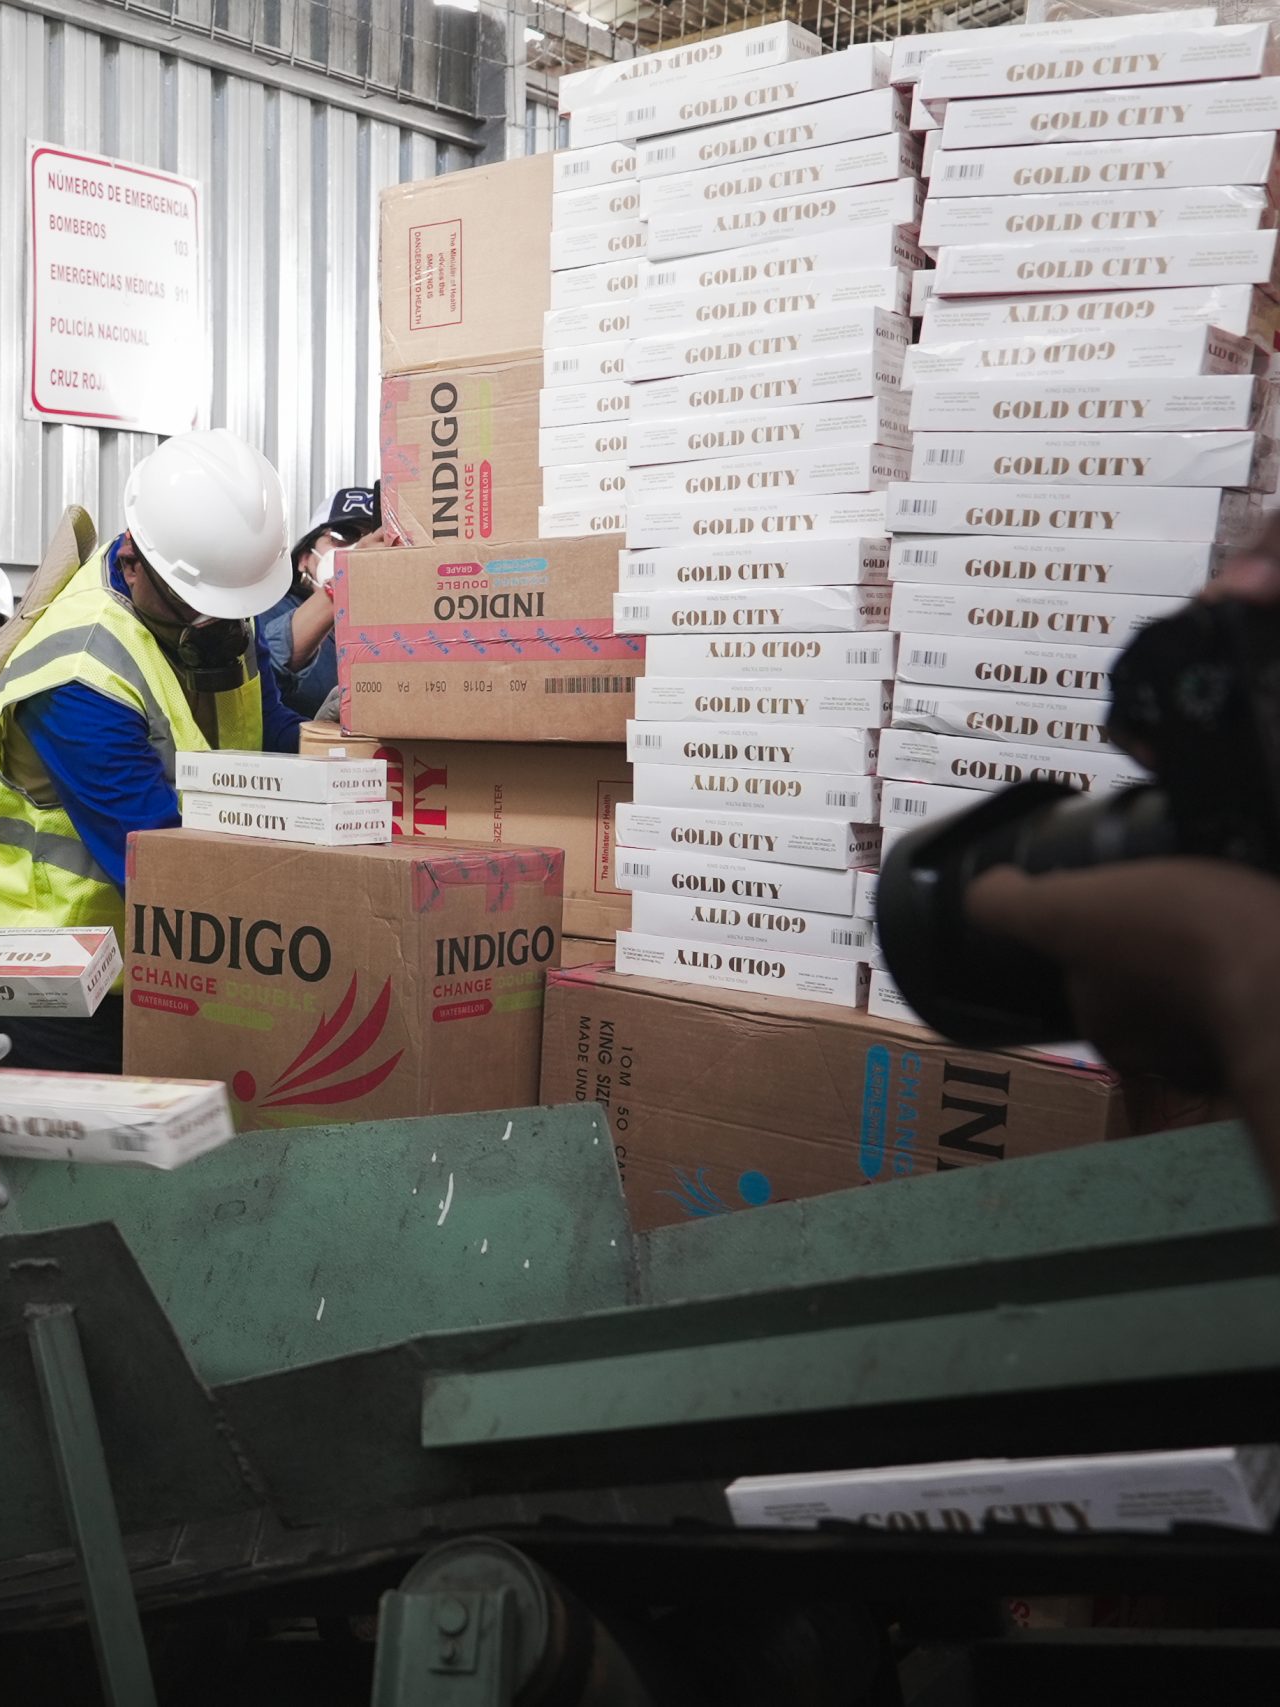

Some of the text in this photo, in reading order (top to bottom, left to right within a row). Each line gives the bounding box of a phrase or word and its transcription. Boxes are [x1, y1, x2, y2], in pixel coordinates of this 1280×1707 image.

[669, 44, 723, 69] GOLD
[1006, 53, 1166, 82] GOLD CITY
[679, 81, 799, 120] GOLD CITY
[1030, 108, 1109, 131] GOLD
[1117, 105, 1191, 127] CITY
[699, 123, 818, 161] GOLD CITY
[704, 165, 823, 200] GOLD CITY
[1013, 161, 1173, 186] GOLD CITY
[48, 170, 189, 218] NÚMEROS DE EMERGENCIA
[49, 214, 107, 239] BOMBEROS
[713, 200, 836, 233] GOLD CITY
[1006, 213, 1082, 232] GOLD
[1091, 210, 1164, 230] CITY
[608, 233, 647, 251] GOL
[50, 263, 122, 291] EMERGENCIAS
[699, 255, 818, 287] GOLD CITY
[1016, 260, 1093, 279] GOLD
[1101, 257, 1174, 276] CITY
[696, 293, 820, 322] GOLD CITY
[1002, 300, 1154, 324] GOLD CITY
[50, 316, 150, 346] POLICÍA NACIONAL
[685, 335, 802, 364] GOLD CITY
[976, 341, 1115, 368] GOLD CITY
[50, 368, 78, 388] CRUZ
[875, 371, 897, 385] GOLD
[689, 378, 802, 408] GOLD CITY
[993, 400, 1069, 420] GOLD
[1078, 400, 1151, 419] CITY
[688, 423, 805, 450] GOLD CITY
[879, 418, 898, 431] GOLD
[431, 382, 459, 539] INDIGO
[871, 464, 892, 477] GOLD
[994, 457, 1151, 476] GOLD CITY
[686, 469, 799, 494] GOLD CITY
[464, 463, 475, 540] CHANGE
[482, 471, 490, 529] WATERMELON
[590, 514, 625, 531] GOL
[693, 514, 818, 536] GOLD CITY
[965, 507, 1120, 530] GOLD CITY
[445, 565, 473, 575] GRAPE
[677, 562, 789, 583] GOLD CITY
[863, 558, 886, 568] GOLD
[965, 558, 1114, 583] GOLD CITY
[437, 579, 488, 590] DOUBLE
[434, 591, 545, 621] INDIGO
[672, 608, 784, 626] GOLD CITY
[858, 606, 881, 616] GOLD
[968, 607, 1116, 634] GOLD CITY
[705, 641, 821, 659] GOLD CITY
[355, 680, 527, 693] A03 F0116 0541 PA 00020
[975, 662, 1113, 690] GOLD CIT
[695, 695, 751, 713] GOLD
[757, 697, 808, 715] CITY
[966, 711, 1038, 735] GOLD
[684, 742, 794, 763] GOLD CITY
[212, 772, 283, 792] GOLD CITY
[332, 778, 384, 789] GOLD CITY
[691, 774, 802, 797] GOLD CITY
[493, 784, 503, 820] FILTER
[219, 810, 253, 827] GOLD
[256, 814, 288, 831] CITY
[335, 821, 362, 831] GOLD
[364, 820, 386, 829] CITY
[601, 794, 611, 880] The Minister of Health
[671, 827, 723, 847] GOLD
[729, 832, 779, 852] CITY
[849, 840, 873, 853] GOLD
[672, 873, 784, 900] GOLD CITY
[691, 906, 806, 934] GOLD CITY
[132, 904, 331, 982] INDIGO
[435, 925, 555, 977] INDIGO
[674, 950, 786, 979] GOLD CITY
[131, 965, 217, 995] CHANGE
[433, 978, 492, 999] CHANGE
[137, 994, 190, 1011] WATERMELON
[439, 1001, 485, 1018] WATERMELON
[597, 1020, 616, 1065] KING
[575, 1015, 592, 1102] MADE UND
[894, 1051, 922, 1176] CHANG
